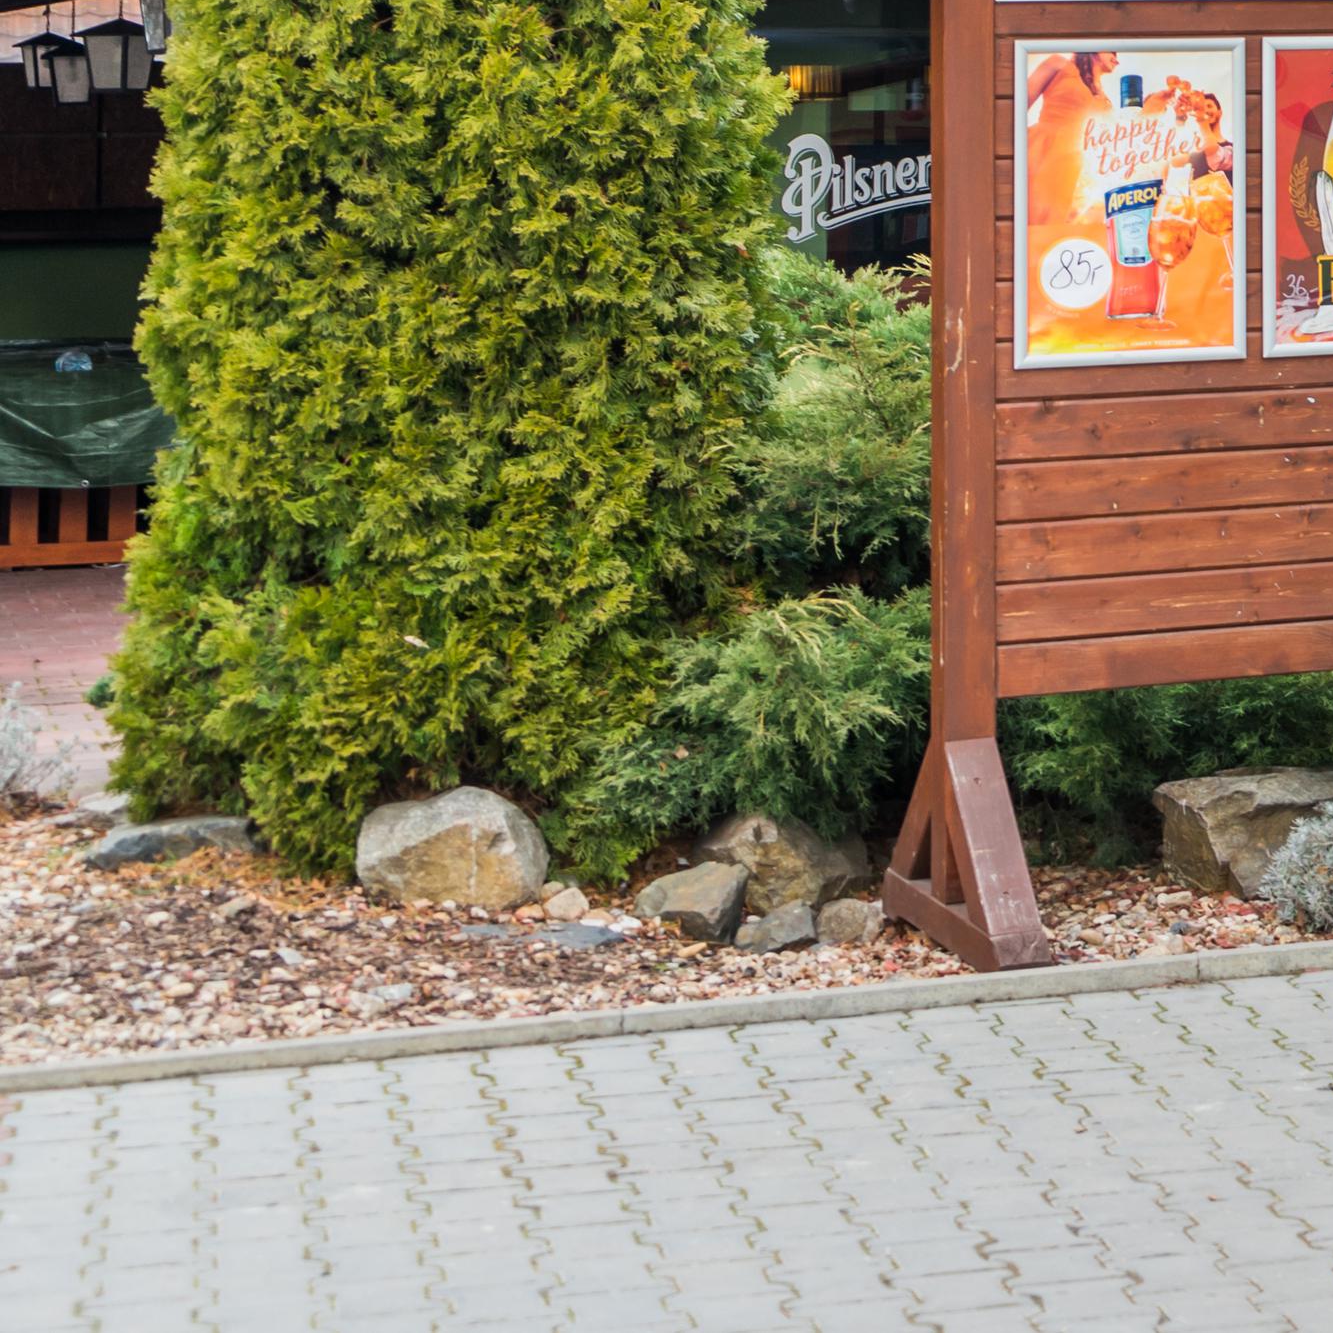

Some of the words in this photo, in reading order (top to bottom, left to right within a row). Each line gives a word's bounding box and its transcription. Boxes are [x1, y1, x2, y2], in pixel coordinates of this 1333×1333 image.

[1083, 118, 1159, 151] happy
[1097, 129, 1204, 179] together
[781, 133, 932, 243] Pilsner
[1107, 186, 1160, 213] APEROL
